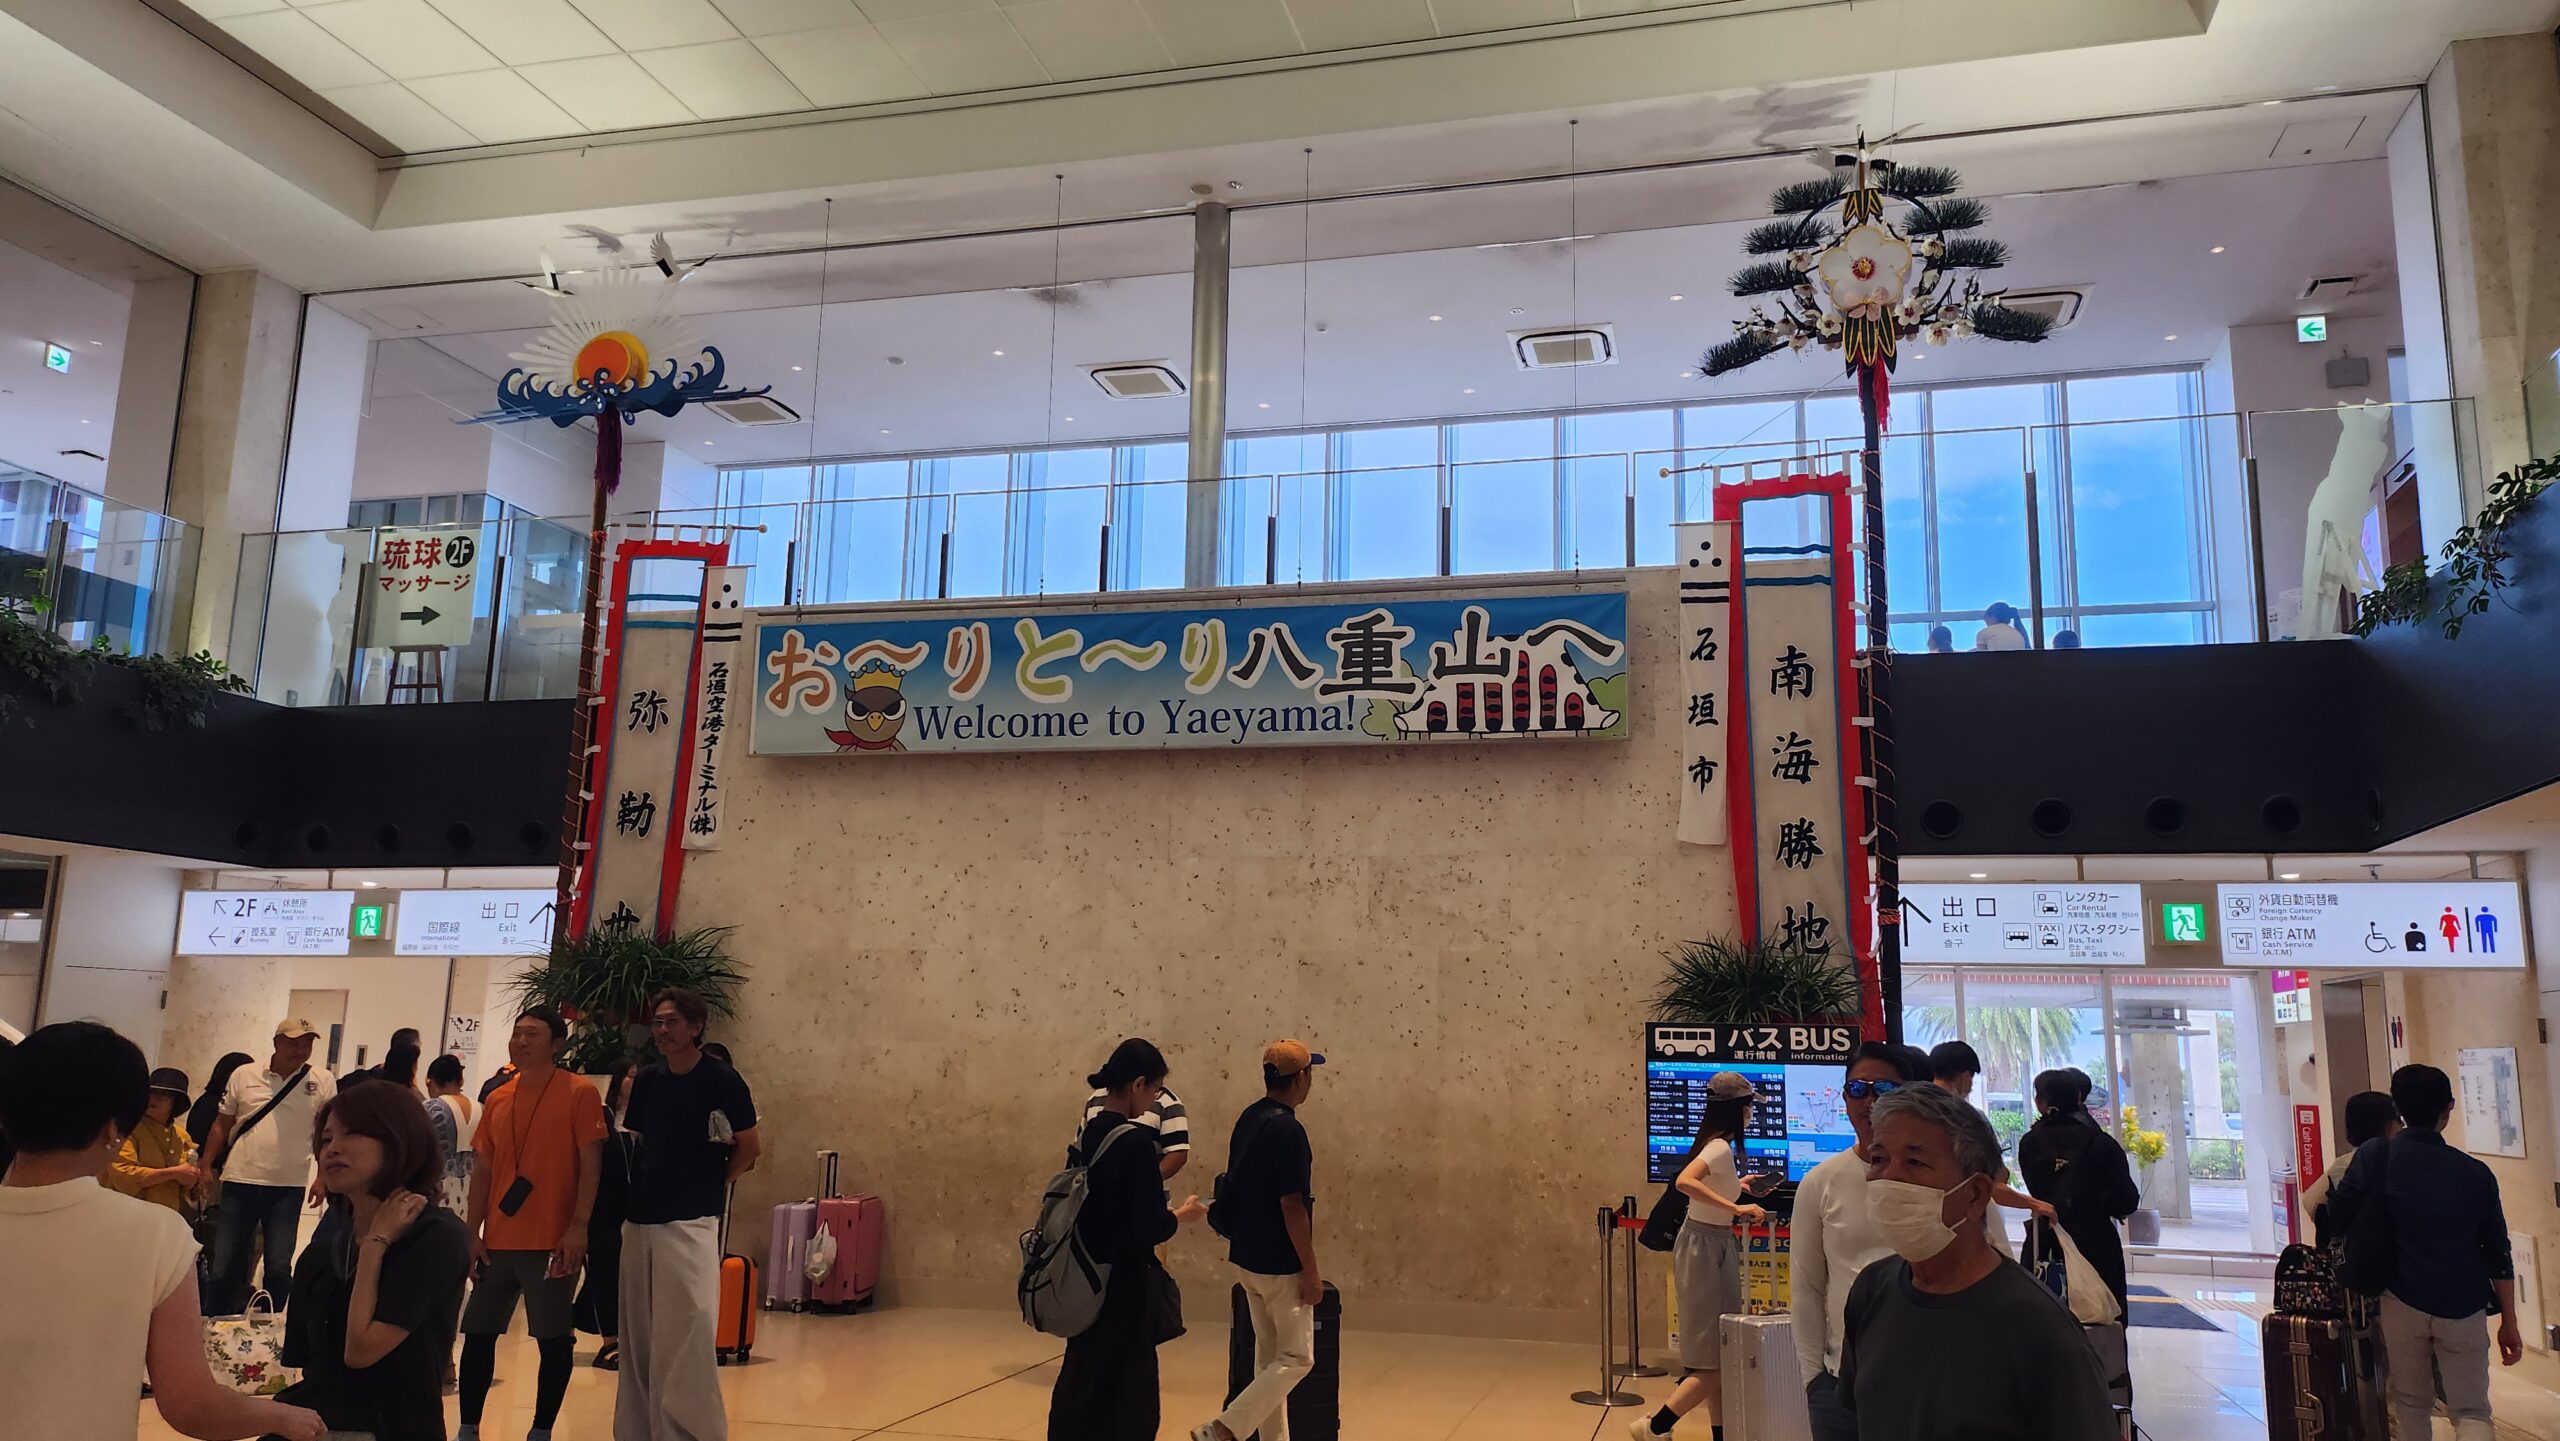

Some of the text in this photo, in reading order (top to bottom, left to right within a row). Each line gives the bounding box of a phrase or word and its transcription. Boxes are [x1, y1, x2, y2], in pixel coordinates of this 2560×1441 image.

[382, 538, 443, 570] 琉球
[449, 539, 471, 564] 2F
[379, 574, 471, 592] マッサージ
[1687, 626, 1719, 796] 石垣市
[913, 694, 1355, 744] Welcome to Yaeyama!
[1768, 644, 1832, 958] 南海勝地
[2065, 891, 2120, 903] レンタカー
[2258, 893, 2339, 906] 外貨自動両替機
[234, 898, 257, 918] 2F
[481, 901, 519, 919] 出口
[1942, 896, 1997, 917] 出口
[2259, 907, 2322, 916] Foreign Currency
[2260, 914, 2288, 922] Change
[322, 927, 345, 937] ATM
[498, 922, 517, 932] Exit
[1943, 922, 1970, 934] Exit
[2037, 924, 2061, 932] TAXI
[2068, 923, 2141, 935] バス・タクシー
[2261, 927, 2316, 940] 銀行 ATM
[465, 1018, 480, 1032] 2F
[1727, 1027, 1851, 1052] バス BUS
[1733, 1049, 1777, 1061] 運行情報
[2302, 1127, 2314, 1176] Cash Exchange
